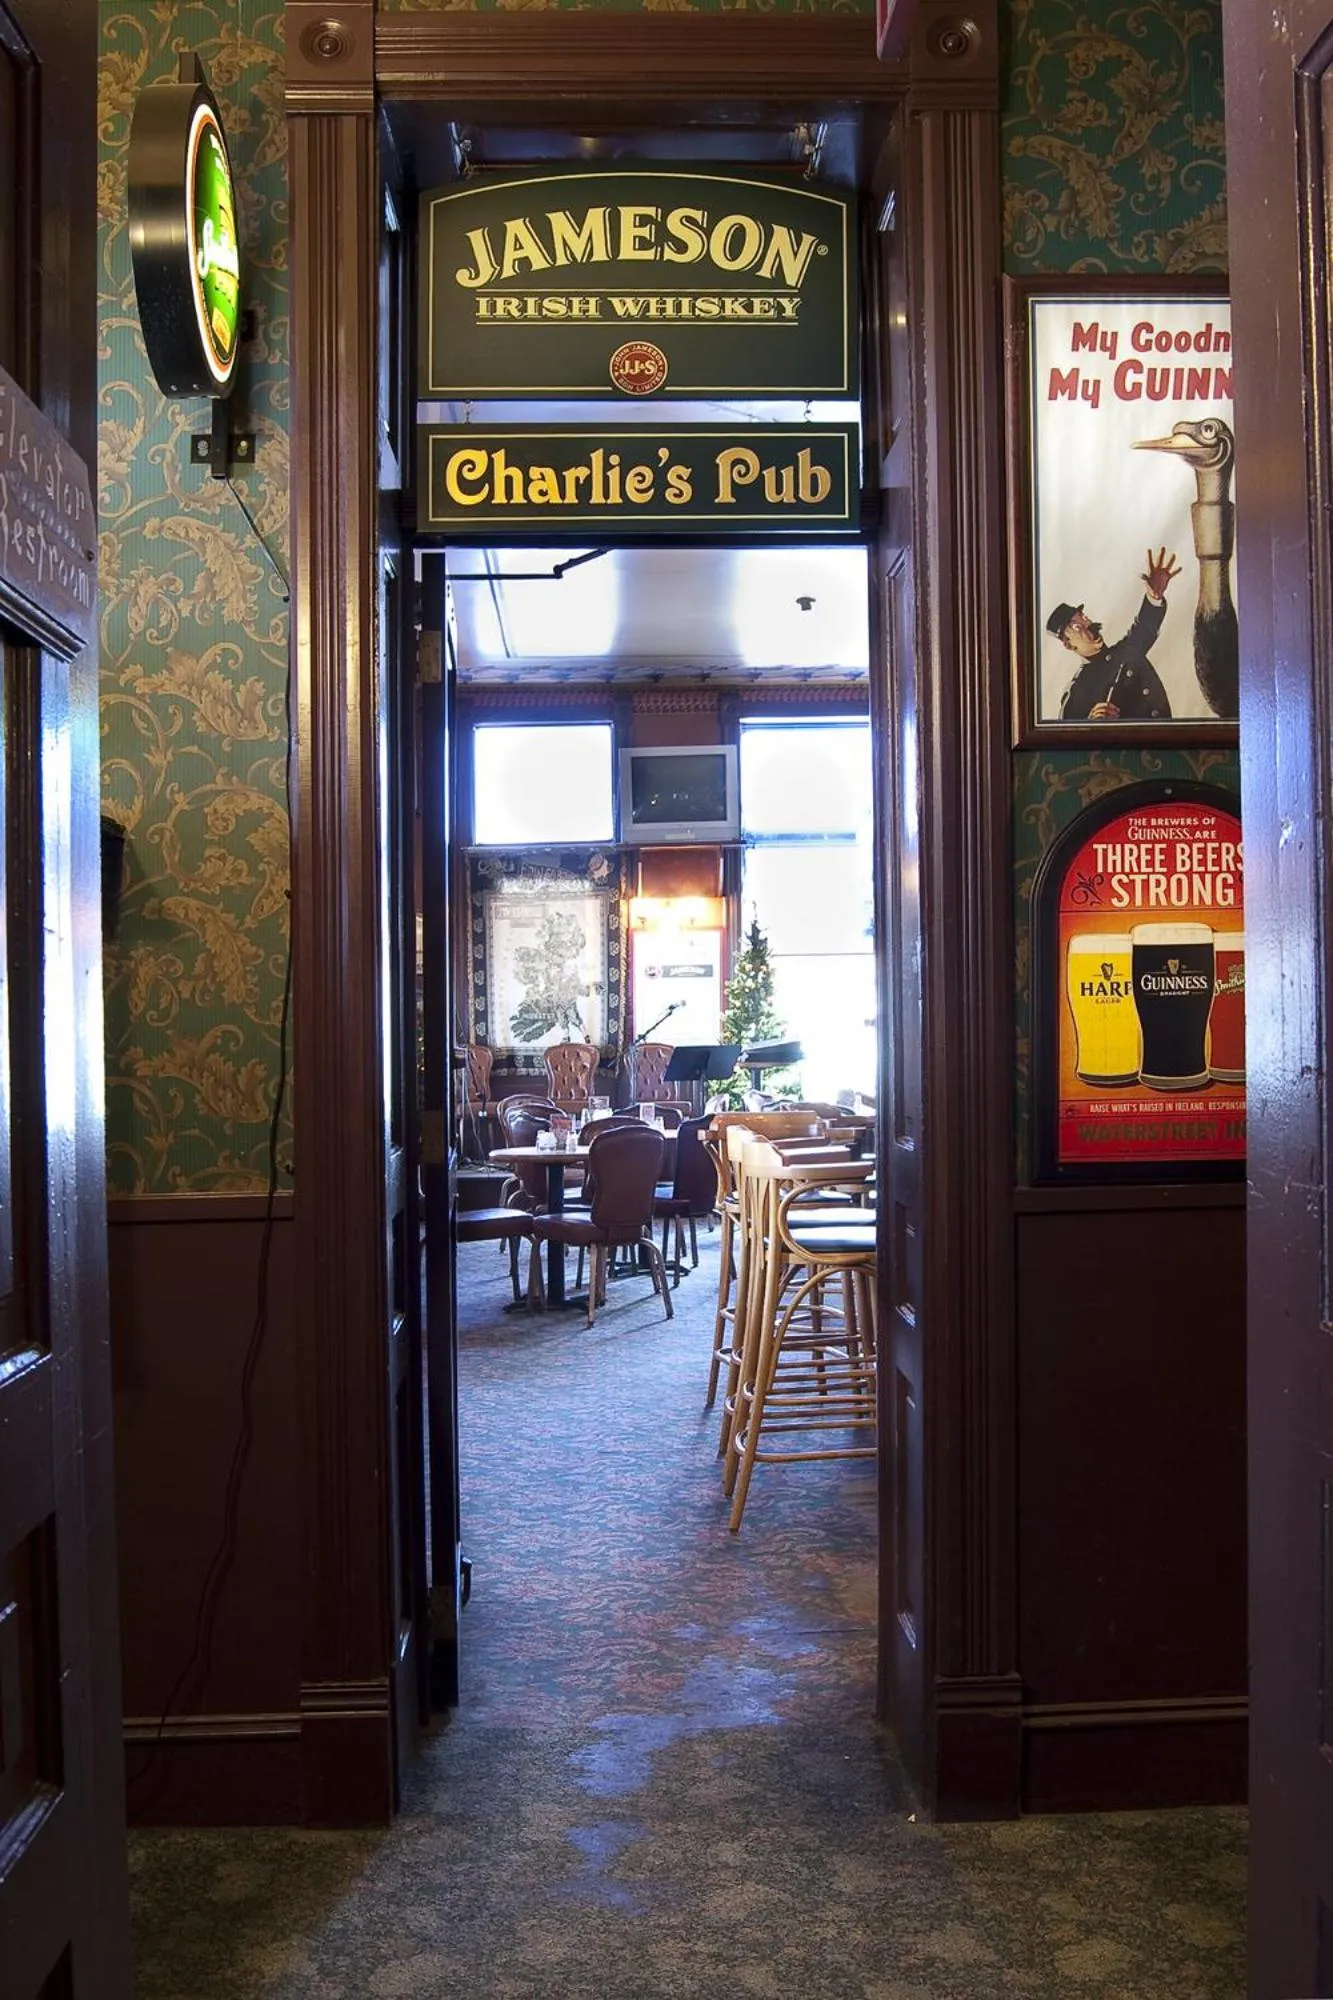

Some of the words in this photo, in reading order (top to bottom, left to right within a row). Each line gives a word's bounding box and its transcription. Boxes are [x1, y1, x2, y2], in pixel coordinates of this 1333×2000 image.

[455, 205, 819, 289] JAMESON
[475, 296, 602, 318] IRISH
[608, 296, 802, 318] WHISKEY
[1071, 322, 1118, 360] My
[1048, 367, 1101, 409] My
[445, 446, 693, 505] Charlie's
[713, 446, 832, 504] Pub
[1128, 817, 1147, 826] THE
[1151, 817, 1199, 826] BREWERS
[1202, 816, 1216, 825] OF
[1128, 826, 1191, 841] GUINNESS
[1194, 830, 1217, 840] ARE
[1092, 843, 1168, 873] THREE
[1111, 873, 1234, 907] STRONG
[1140, 974, 1208, 991] GUINNESS
[1090, 1104, 1110, 1113] RAISE
[1111, 1103, 1138, 1113] WHAT'S
[1139, 1103, 1165, 1112] RAISED
[1165, 1103, 1174, 1112] IN
